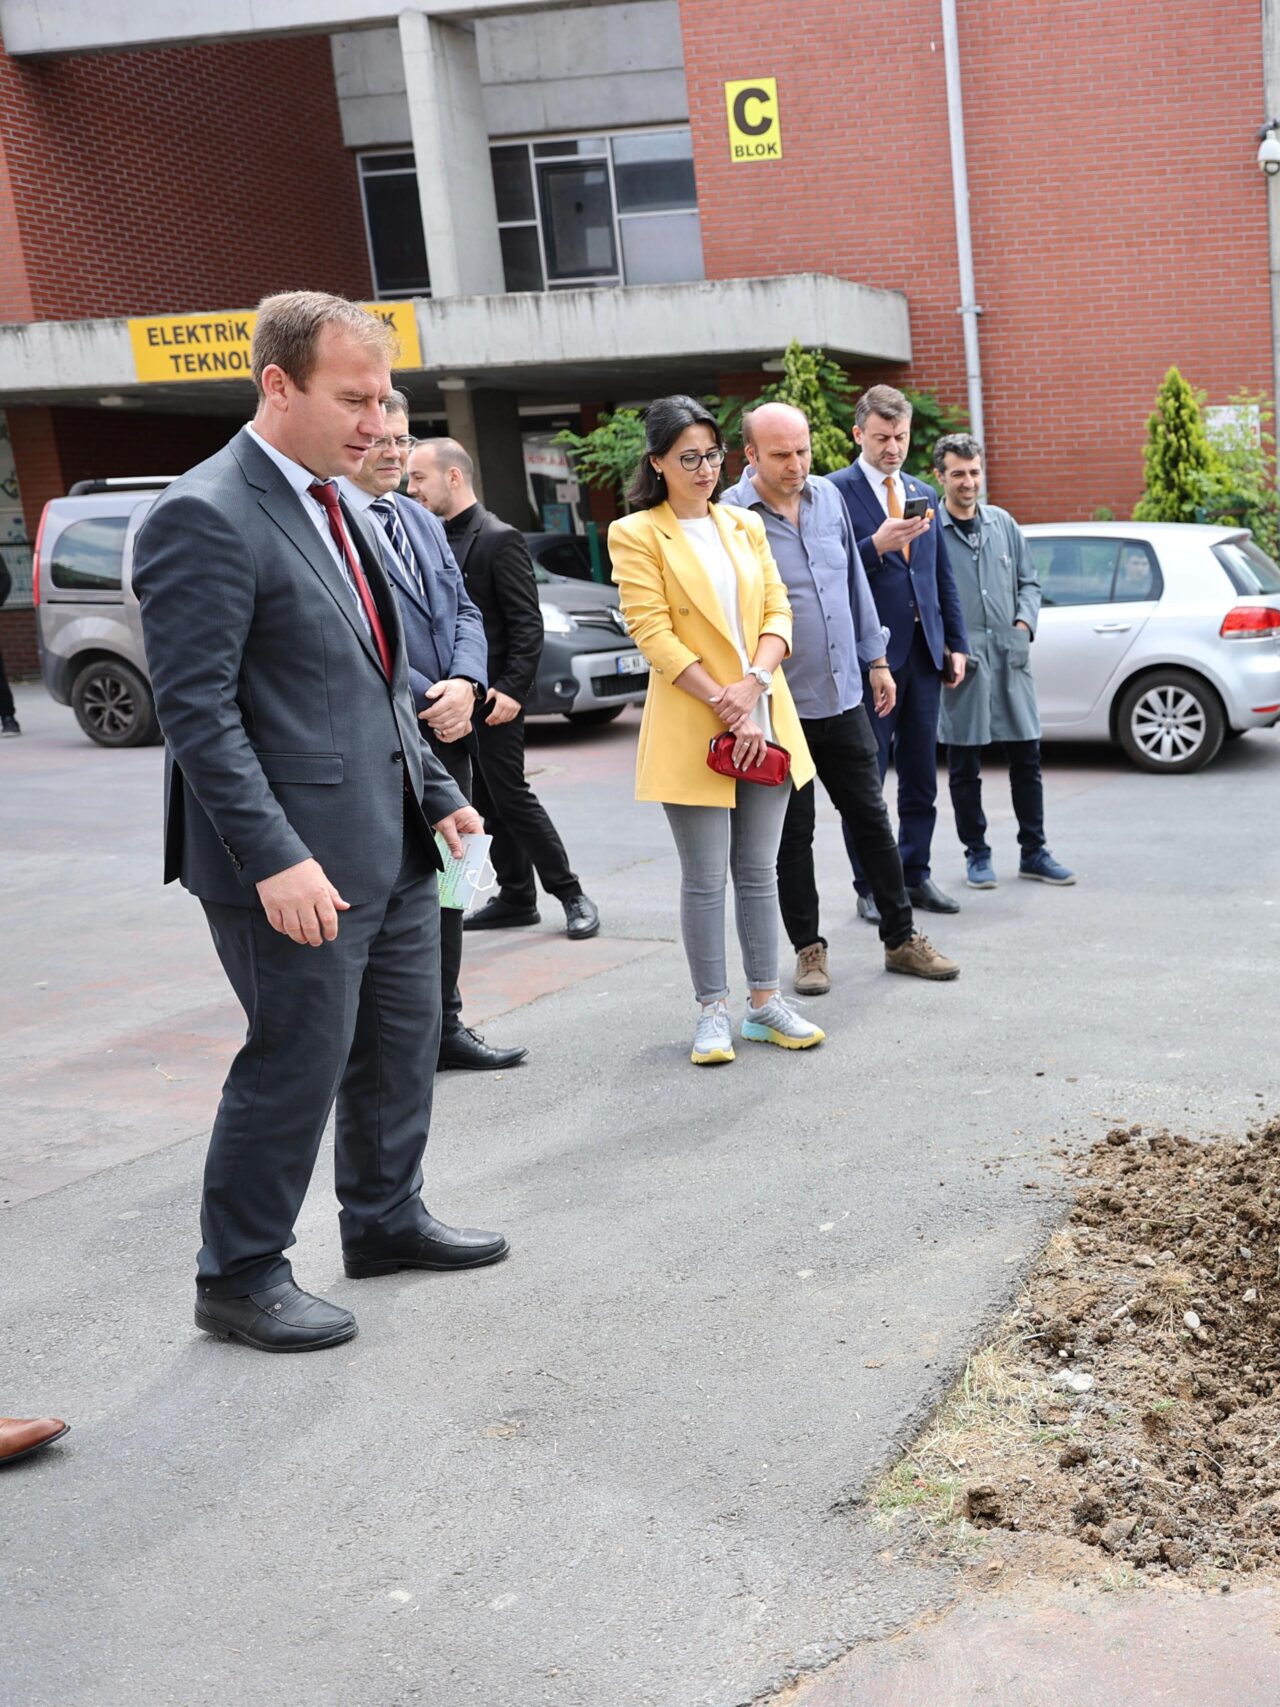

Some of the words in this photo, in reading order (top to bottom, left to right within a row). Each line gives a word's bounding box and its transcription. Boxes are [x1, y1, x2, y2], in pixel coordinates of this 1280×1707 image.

[733, 87, 773, 136] C
[735, 143, 778, 158] BLOK
[146, 320, 251, 347] ELEKTRİK
